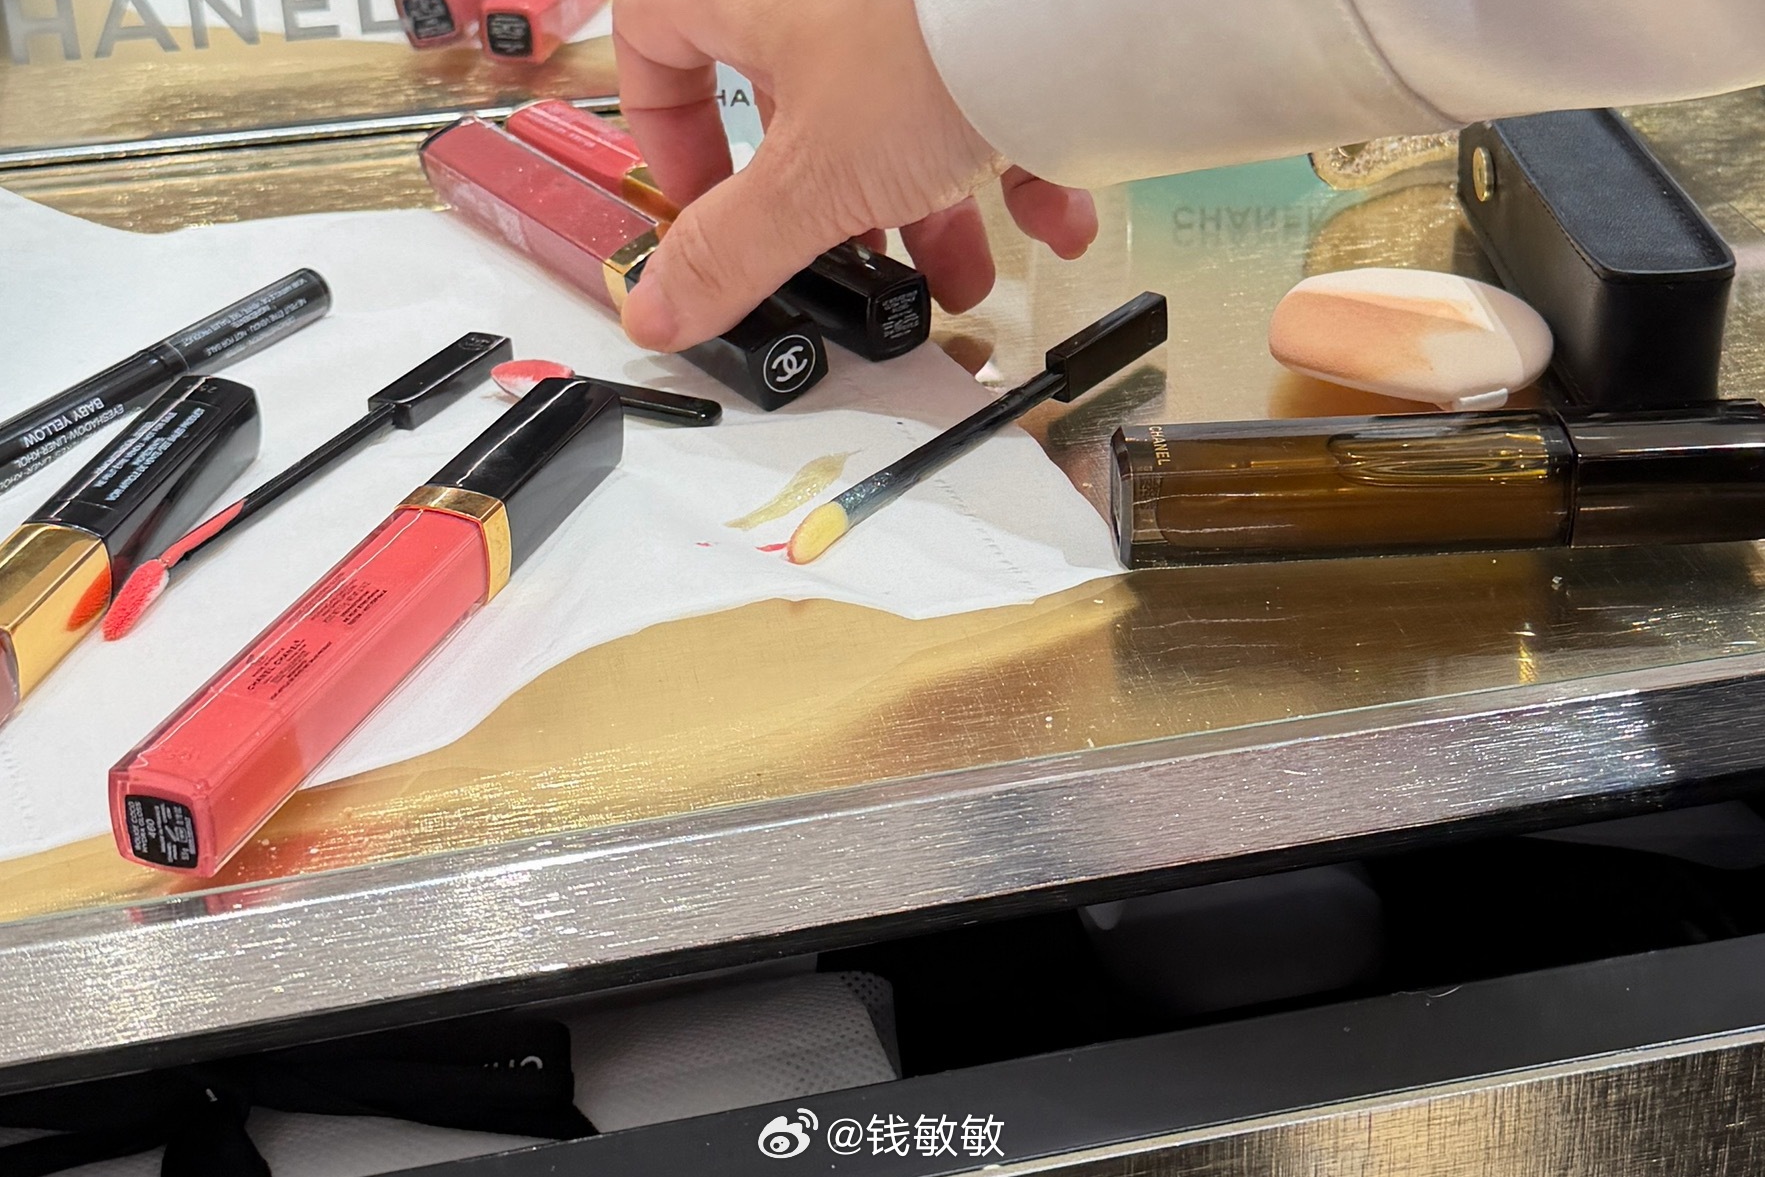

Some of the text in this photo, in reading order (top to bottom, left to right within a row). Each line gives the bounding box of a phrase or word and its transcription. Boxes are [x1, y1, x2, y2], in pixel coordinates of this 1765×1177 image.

[73, 397, 105, 422] BABY
[22, 414, 73, 449] YELLOW
[1148, 426, 1171, 466] CHANEL
[128, 801, 137, 824] COCO
[145, 818, 156, 839] 460
